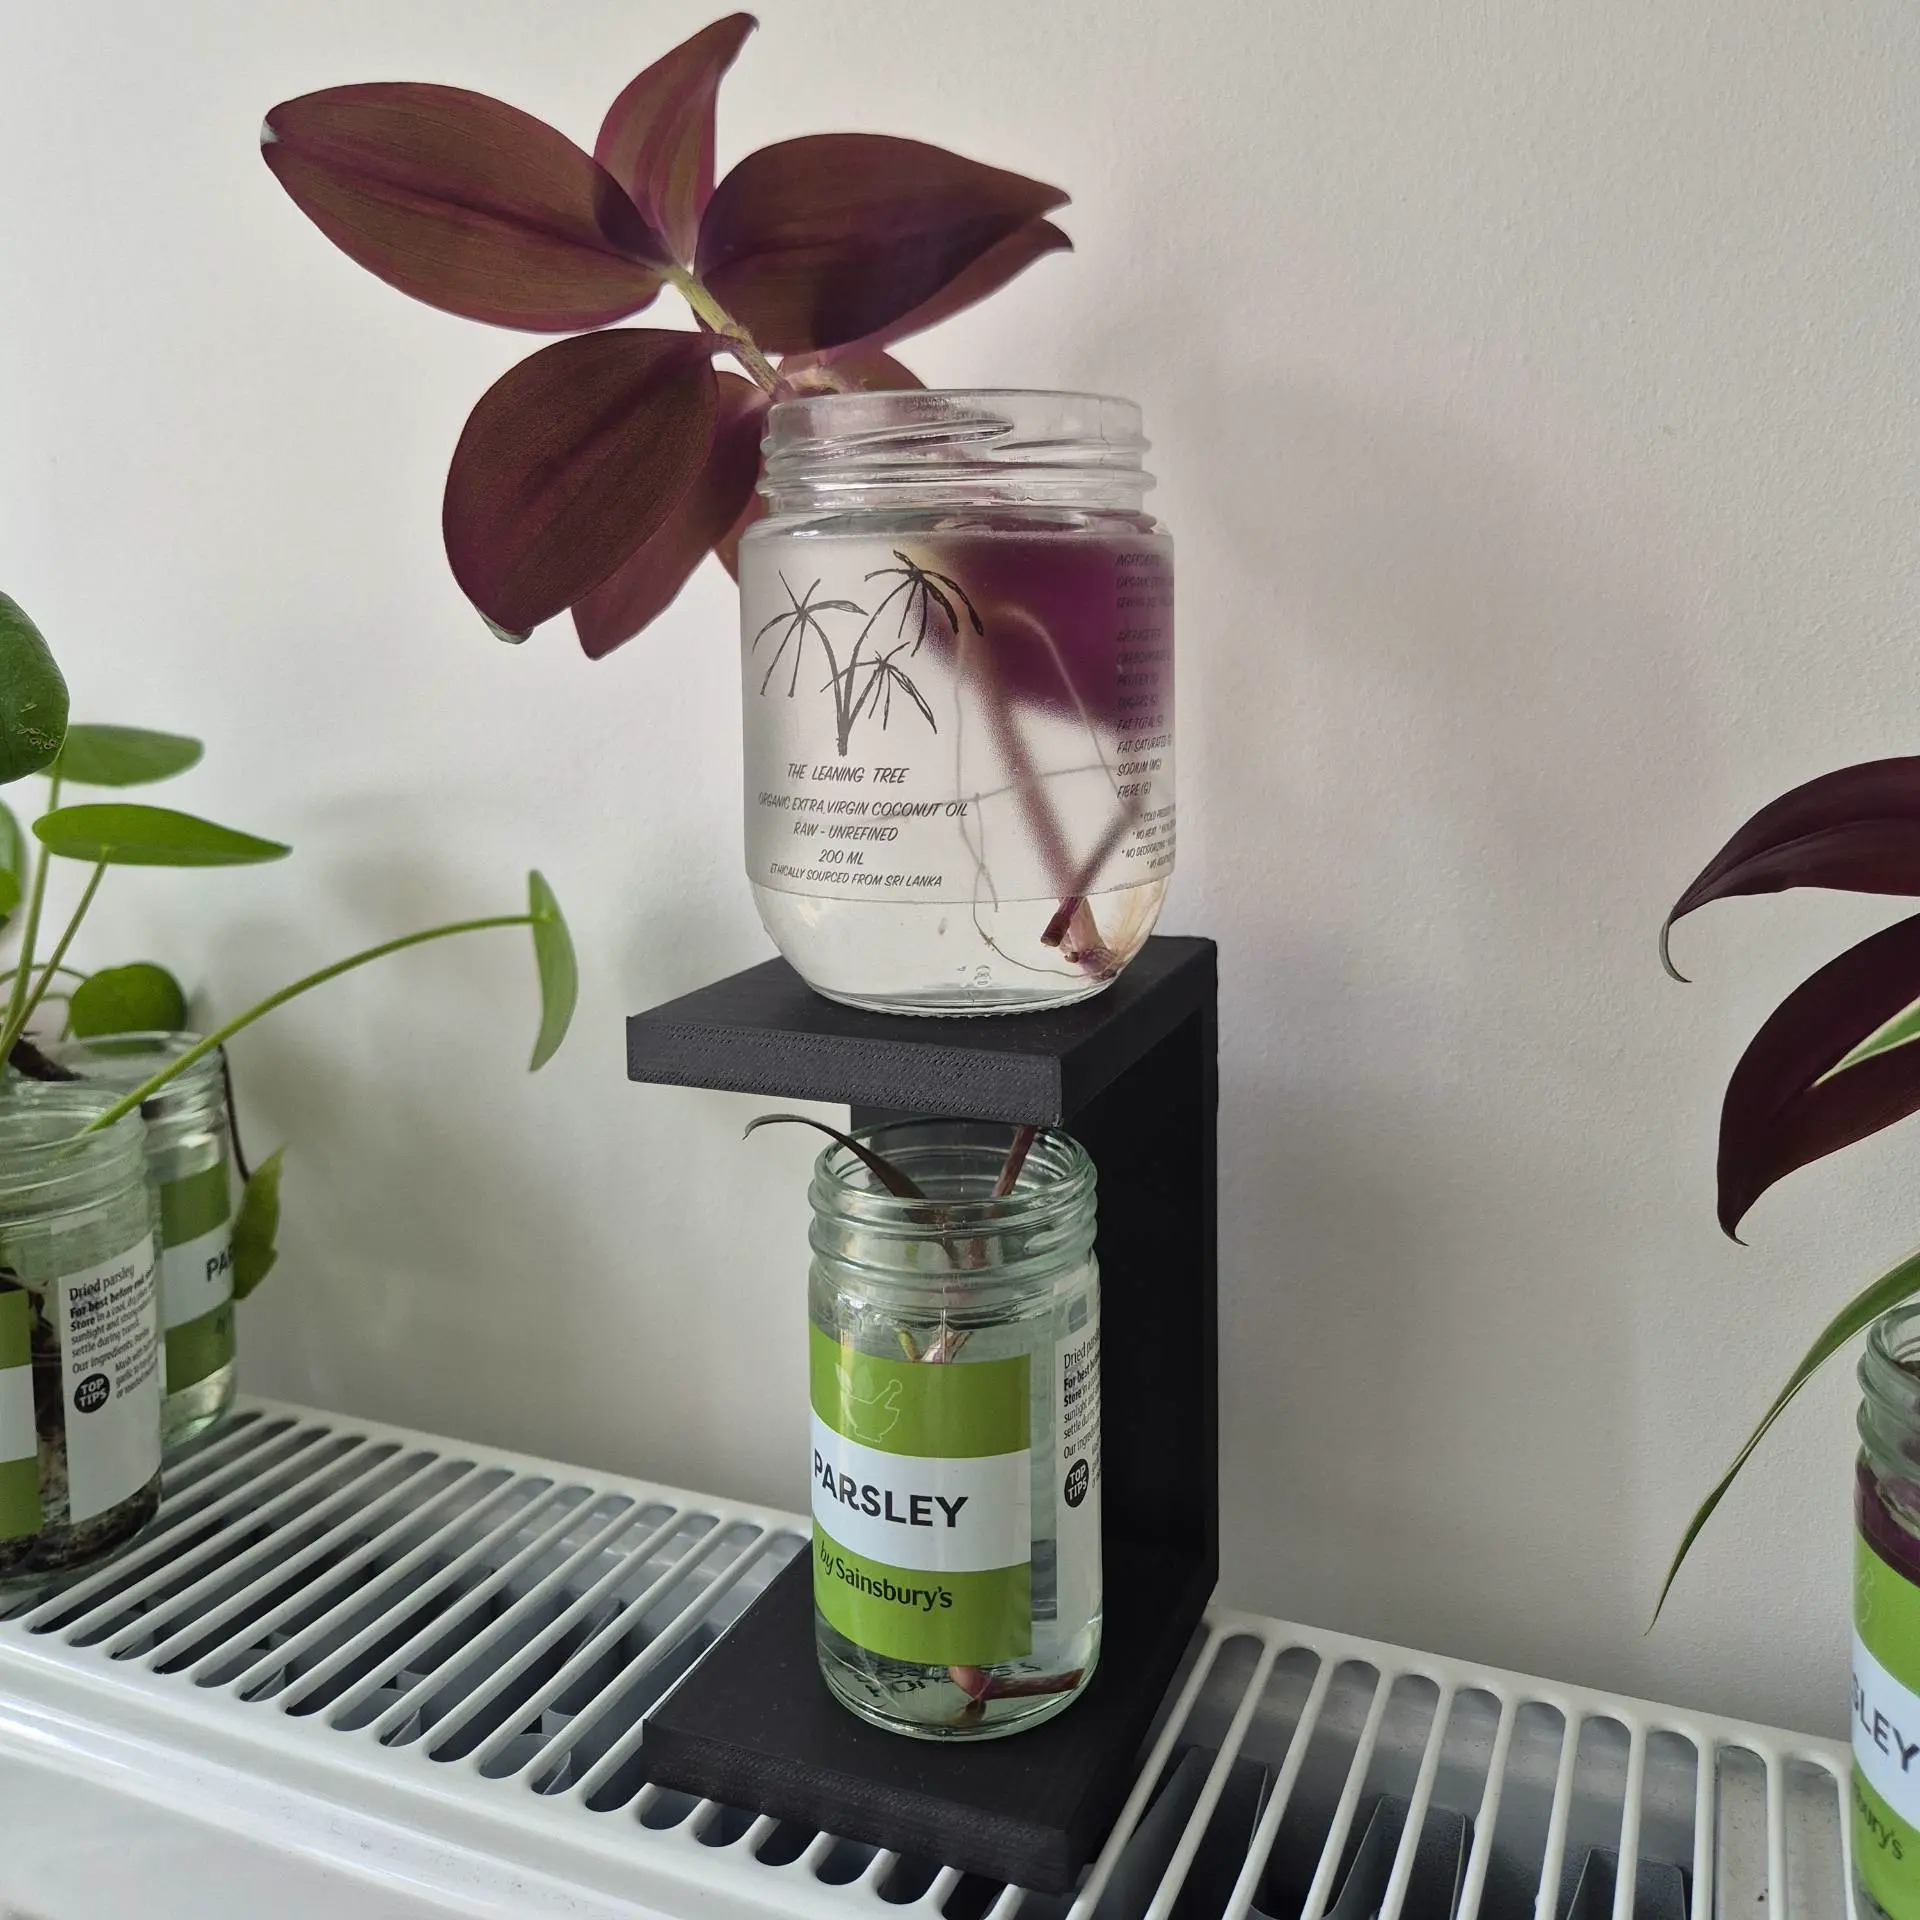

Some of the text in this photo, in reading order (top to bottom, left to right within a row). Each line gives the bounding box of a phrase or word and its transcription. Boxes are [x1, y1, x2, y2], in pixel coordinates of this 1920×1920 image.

[1117, 740, 1133, 754] FAT
[788, 763, 910, 784] THE LEANING TREE
[1117, 760, 1148, 777] SODIUM
[1117, 783, 1140, 799] FIBRE
[758, 791, 790, 810] ORGANIC
[826, 800, 869, 816] VIRGIN
[871, 802, 944, 818] COCONUT
[945, 802, 968, 817] OIL
[793, 821, 819, 837] RAW
[828, 825, 899, 842] UNREFINED
[818, 849, 864, 866] 200 ML
[769, 862, 942, 888] ETHICALLY SOURCED FROM SRI LANKA
[207, 1243, 233, 1283] PA
[69, 1278, 101, 1302] Dried
[70, 1305, 87, 1319] For
[88, 1296, 109, 1313] best
[71, 1316, 96, 1332] Store
[1064, 1340, 1086, 1369] Dried
[80, 1377, 105, 1395] TOP
[1064, 1376, 1077, 1392] For
[1077, 1364, 1090, 1383] best
[80, 1387, 108, 1408] TIPS
[1064, 1388, 1082, 1408] Store
[1064, 1418, 1081, 1440] settle
[1064, 1442, 1077, 1459] Our
[1070, 1464, 1086, 1485] TOP
[814, 1447, 969, 1529] PARSLEY
[1068, 1475, 1088, 1501] TIPS
[820, 1539, 954, 1612] by Sainsbury's
